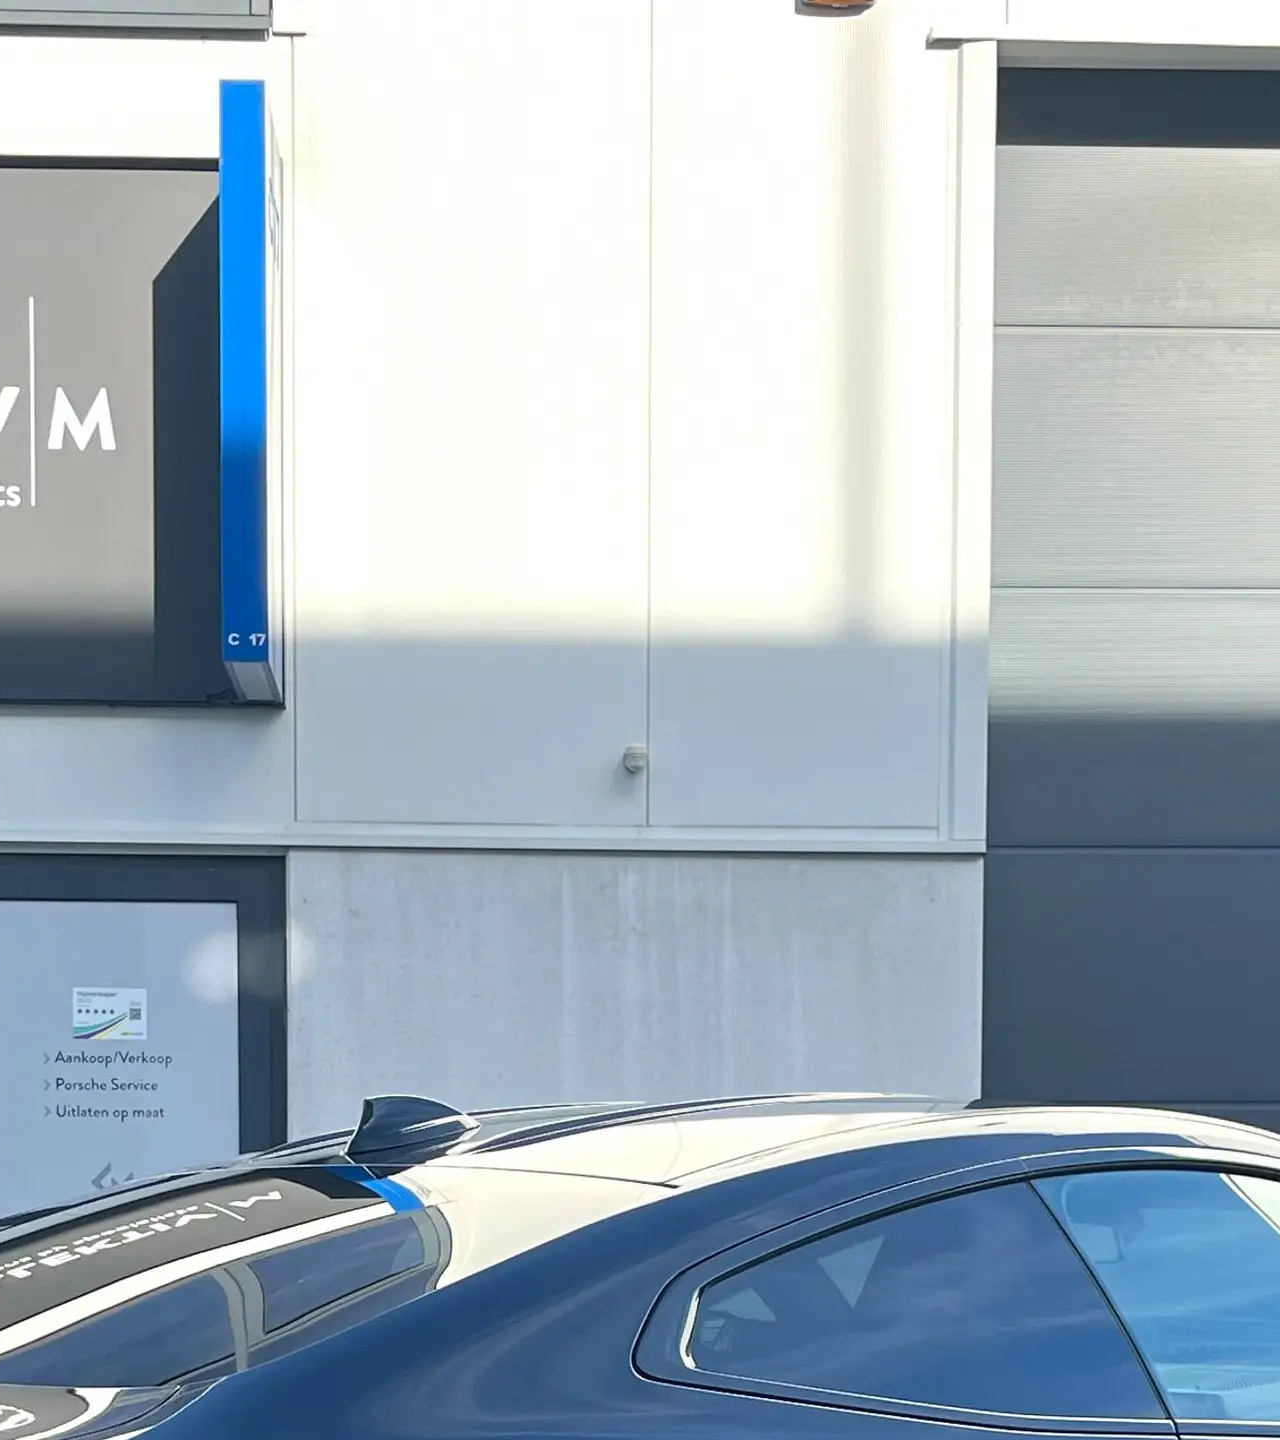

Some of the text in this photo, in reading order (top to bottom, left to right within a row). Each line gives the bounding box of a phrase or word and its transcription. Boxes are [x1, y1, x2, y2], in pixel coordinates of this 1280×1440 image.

[47, 386, 117, 452] M
[227, 632, 267, 647] C 17
[54, 1051, 173, 1068] Aankoop/Verkoop
[55, 1077, 158, 1092] Porsche Service
[56, 1104, 165, 1123] Uitlaten op maat
